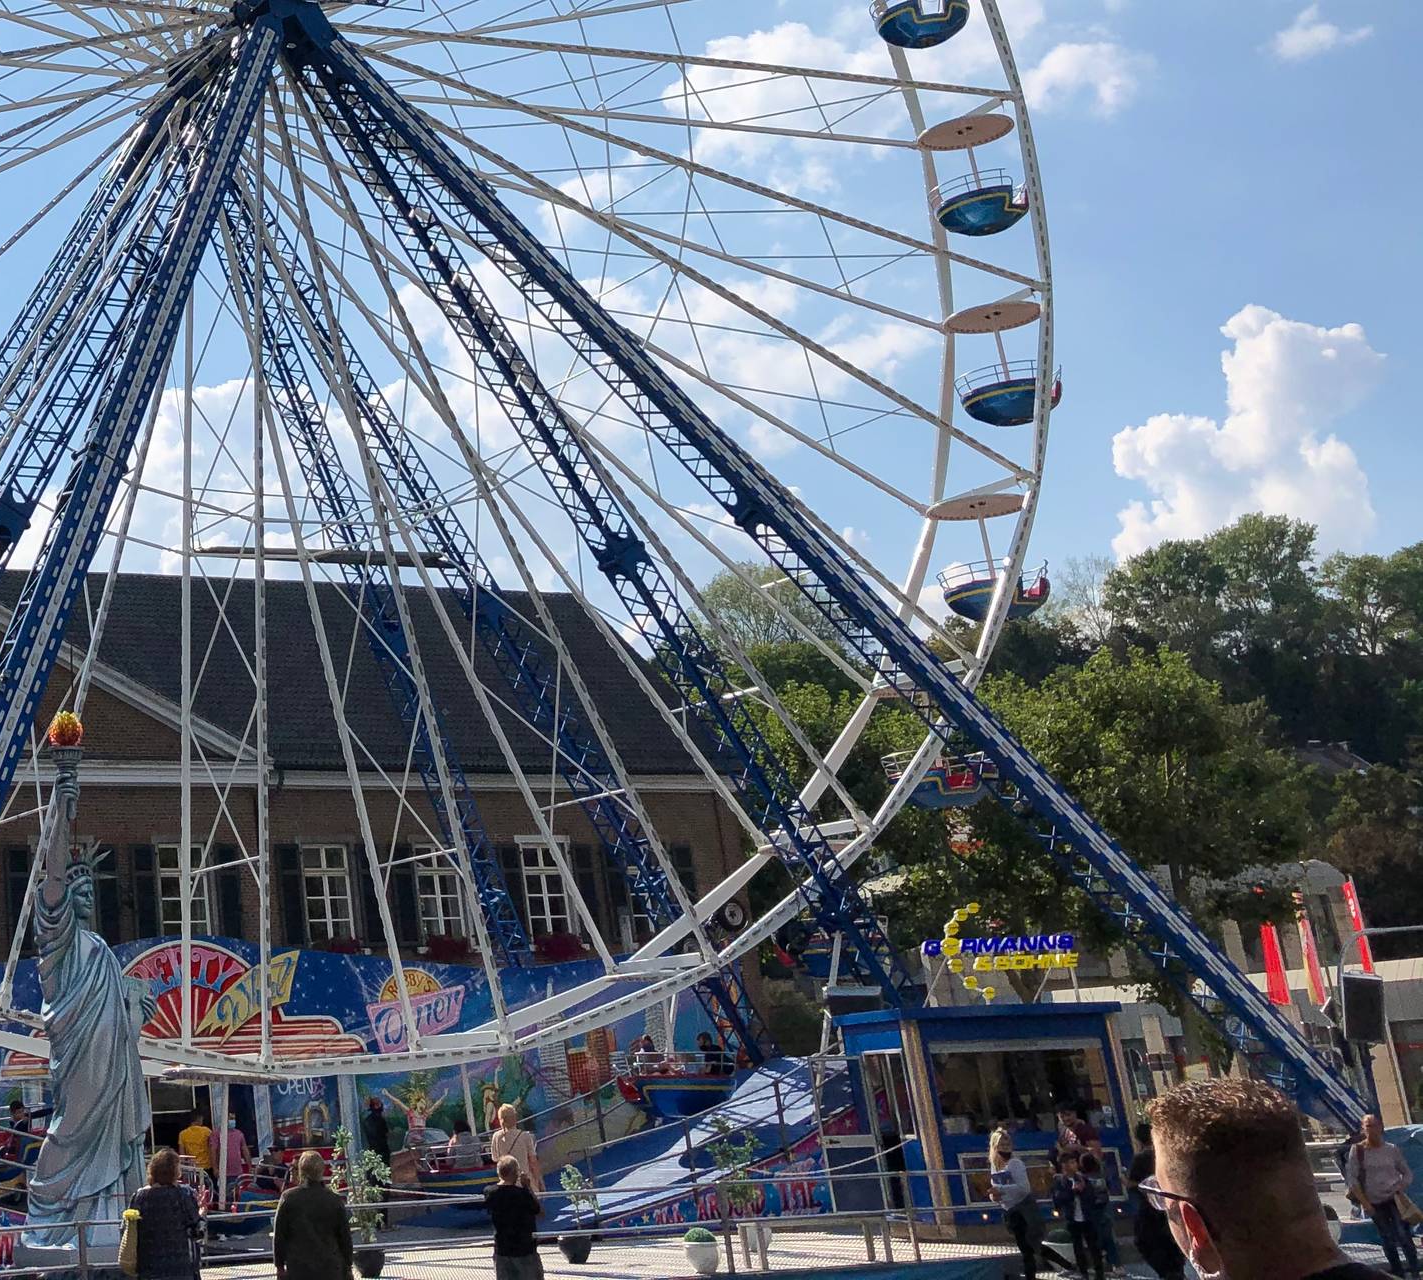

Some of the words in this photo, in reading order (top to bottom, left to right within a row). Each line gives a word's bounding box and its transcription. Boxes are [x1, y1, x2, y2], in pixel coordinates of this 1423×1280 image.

[128, 947, 245, 1000] BERTY
[217, 957, 293, 1025] Whl
[375, 991, 461, 1045] Dner
[277, 1077, 314, 1095] OPEN
[697, 1183, 767, 1221] ARND
